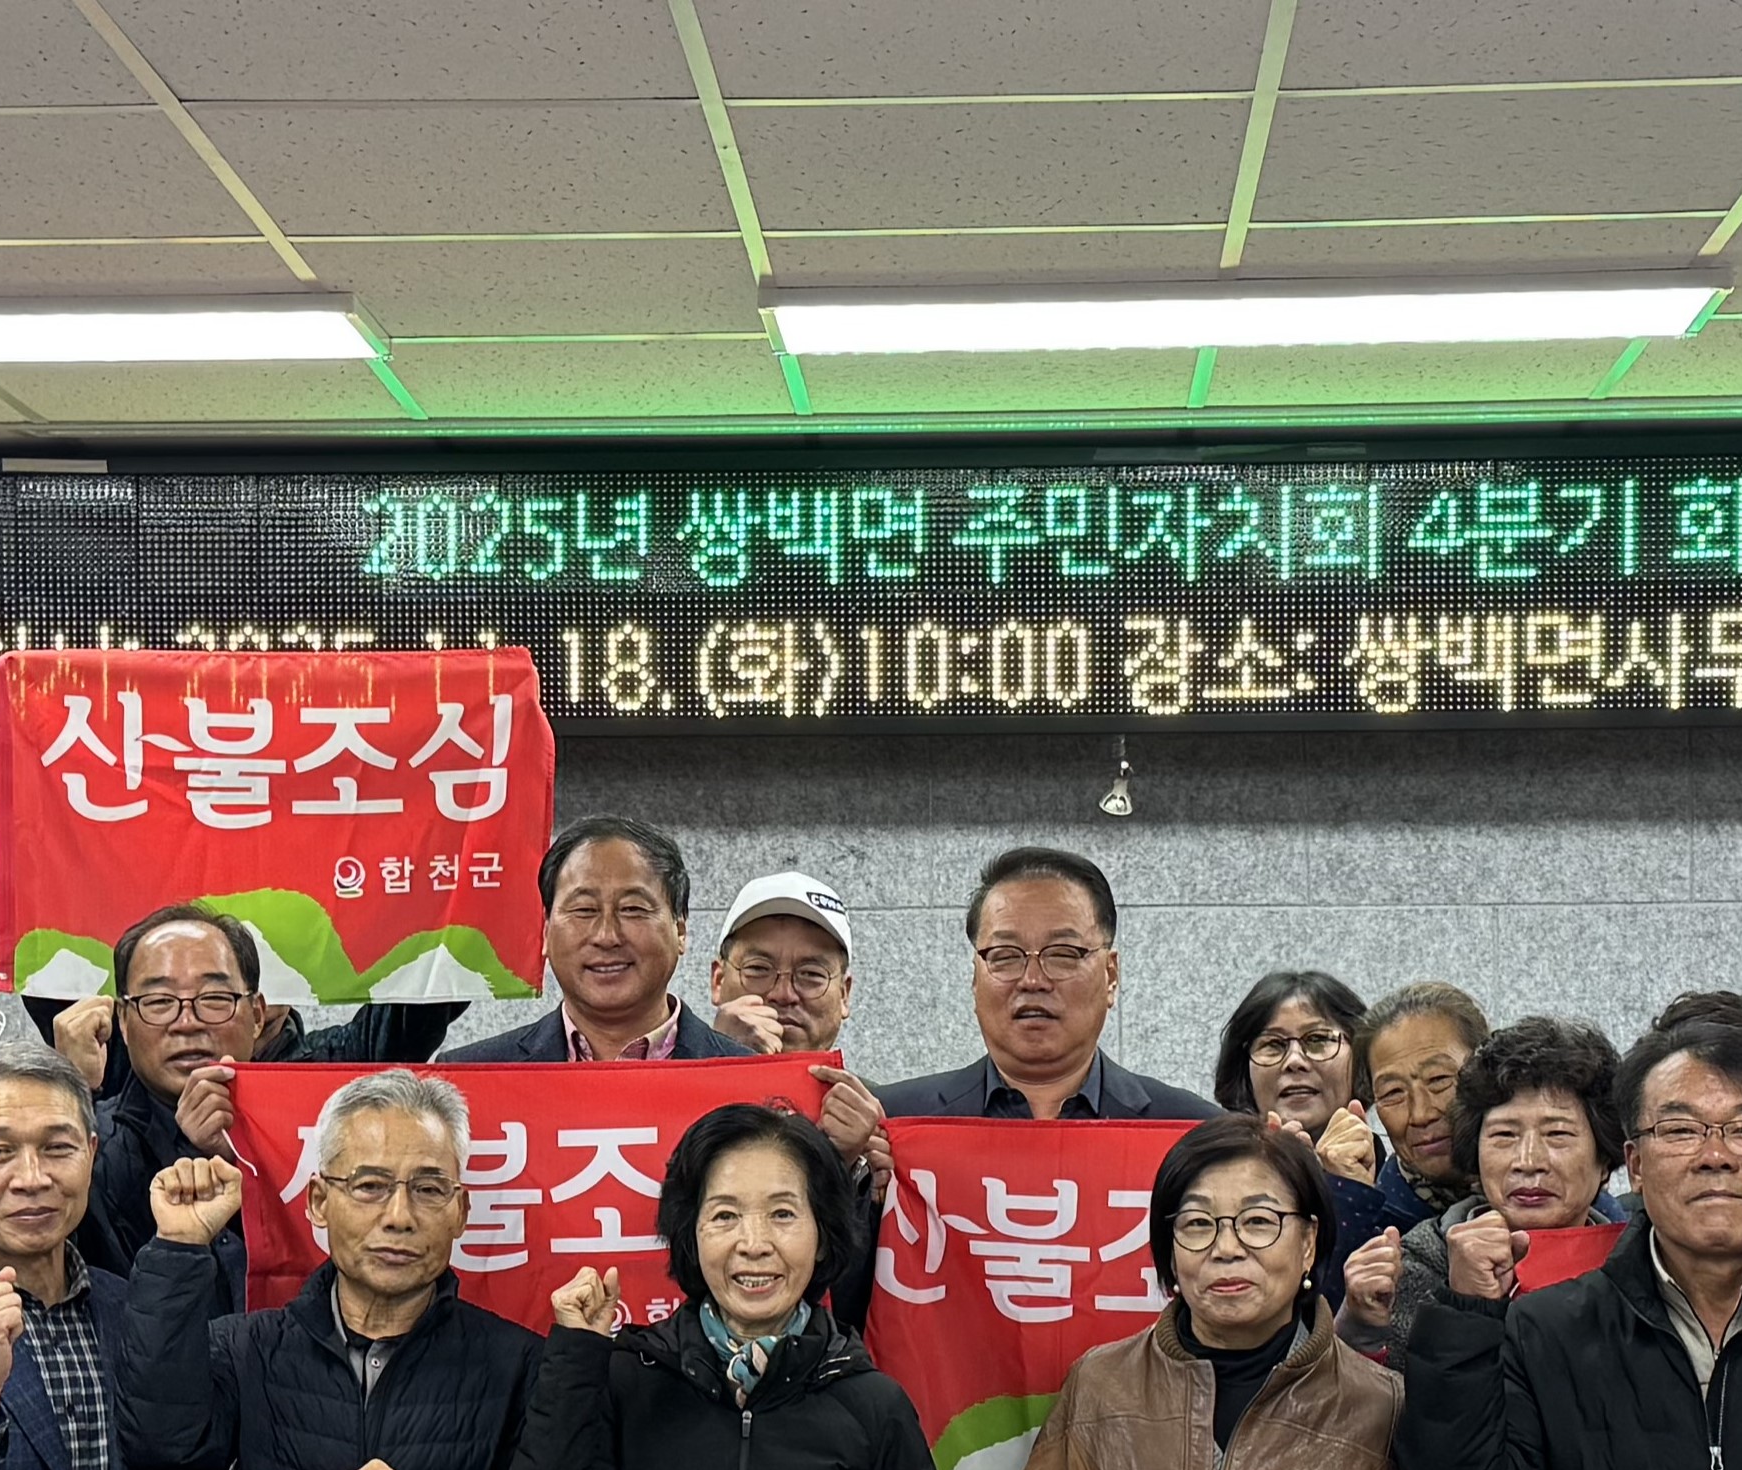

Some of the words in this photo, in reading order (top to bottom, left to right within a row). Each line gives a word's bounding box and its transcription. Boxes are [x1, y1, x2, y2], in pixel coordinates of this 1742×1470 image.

[361, 490, 648, 581] 2025년
[675, 487, 924, 587] 쌍백면
[952, 483, 1379, 583] 주민자치회
[1407, 479, 1636, 579] 4분기
[1122, 616, 1316, 714] 장소:
[41, 691, 514, 830] 산불조심
[377, 852, 504, 895] 합천군
[279, 1120, 669, 1273] 불조
[874, 1168, 1175, 1324] 산불조
